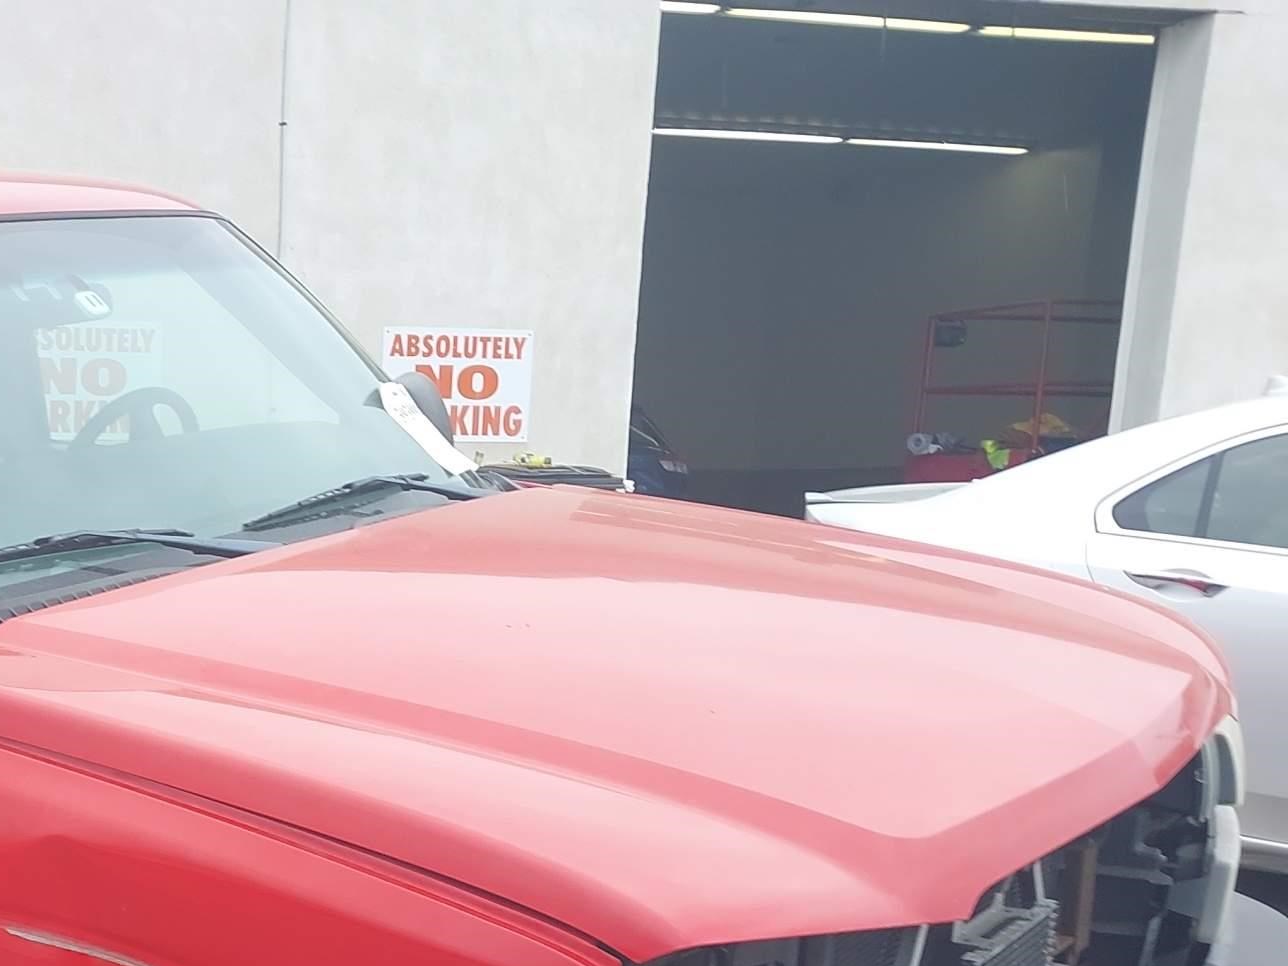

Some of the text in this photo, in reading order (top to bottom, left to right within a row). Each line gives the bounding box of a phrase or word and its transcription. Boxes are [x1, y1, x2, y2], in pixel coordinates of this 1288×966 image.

[390, 334, 527, 359] ABSOLUTELY
[40, 358, 127, 396] NO
[450, 405, 523, 437] KING
